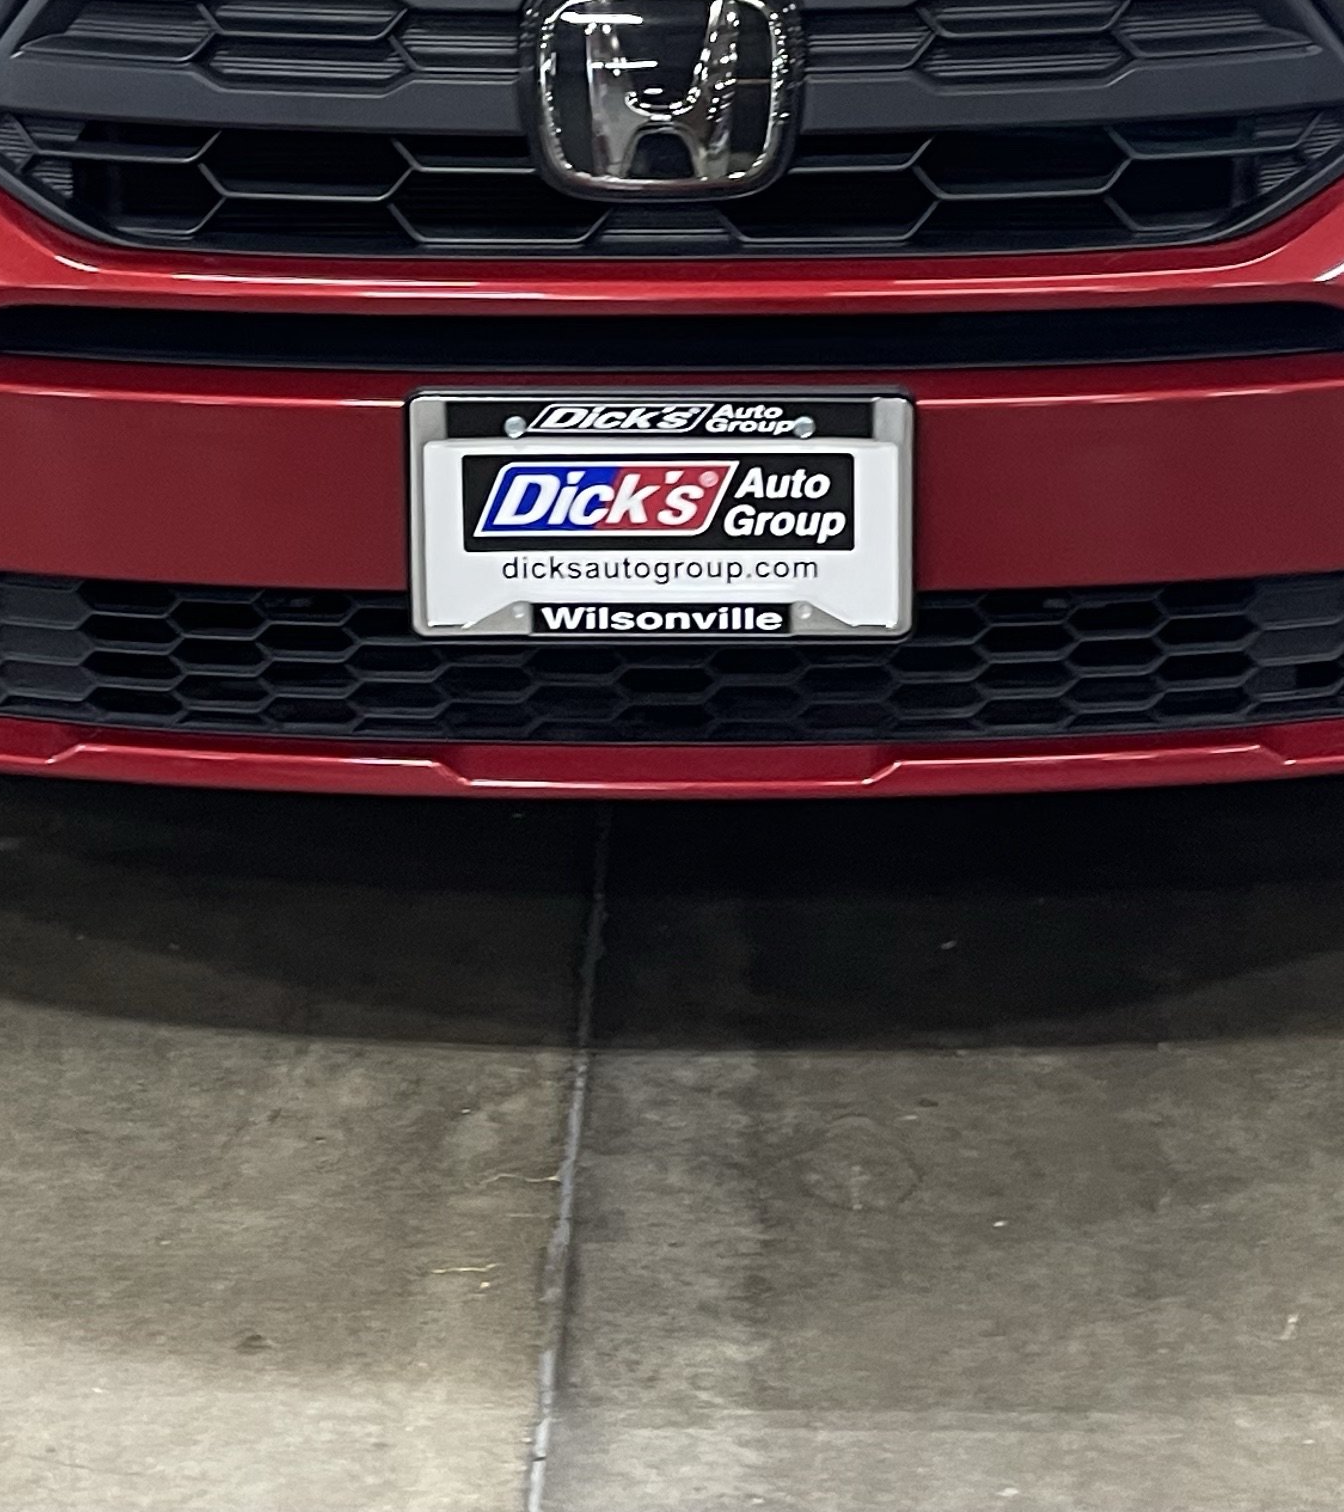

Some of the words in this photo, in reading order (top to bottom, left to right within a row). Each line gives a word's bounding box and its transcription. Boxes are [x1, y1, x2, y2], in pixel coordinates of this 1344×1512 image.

[540, 405, 693, 430] Dick's
[712, 404, 784, 419] Auto
[705, 418, 796, 436] Group
[733, 467, 832, 499] Auto
[492, 470, 706, 526] Dick's
[723, 504, 847, 544] Group
[502, 556, 819, 585] dicksautogroup.com
[541, 606, 784, 631] Wilsonville
